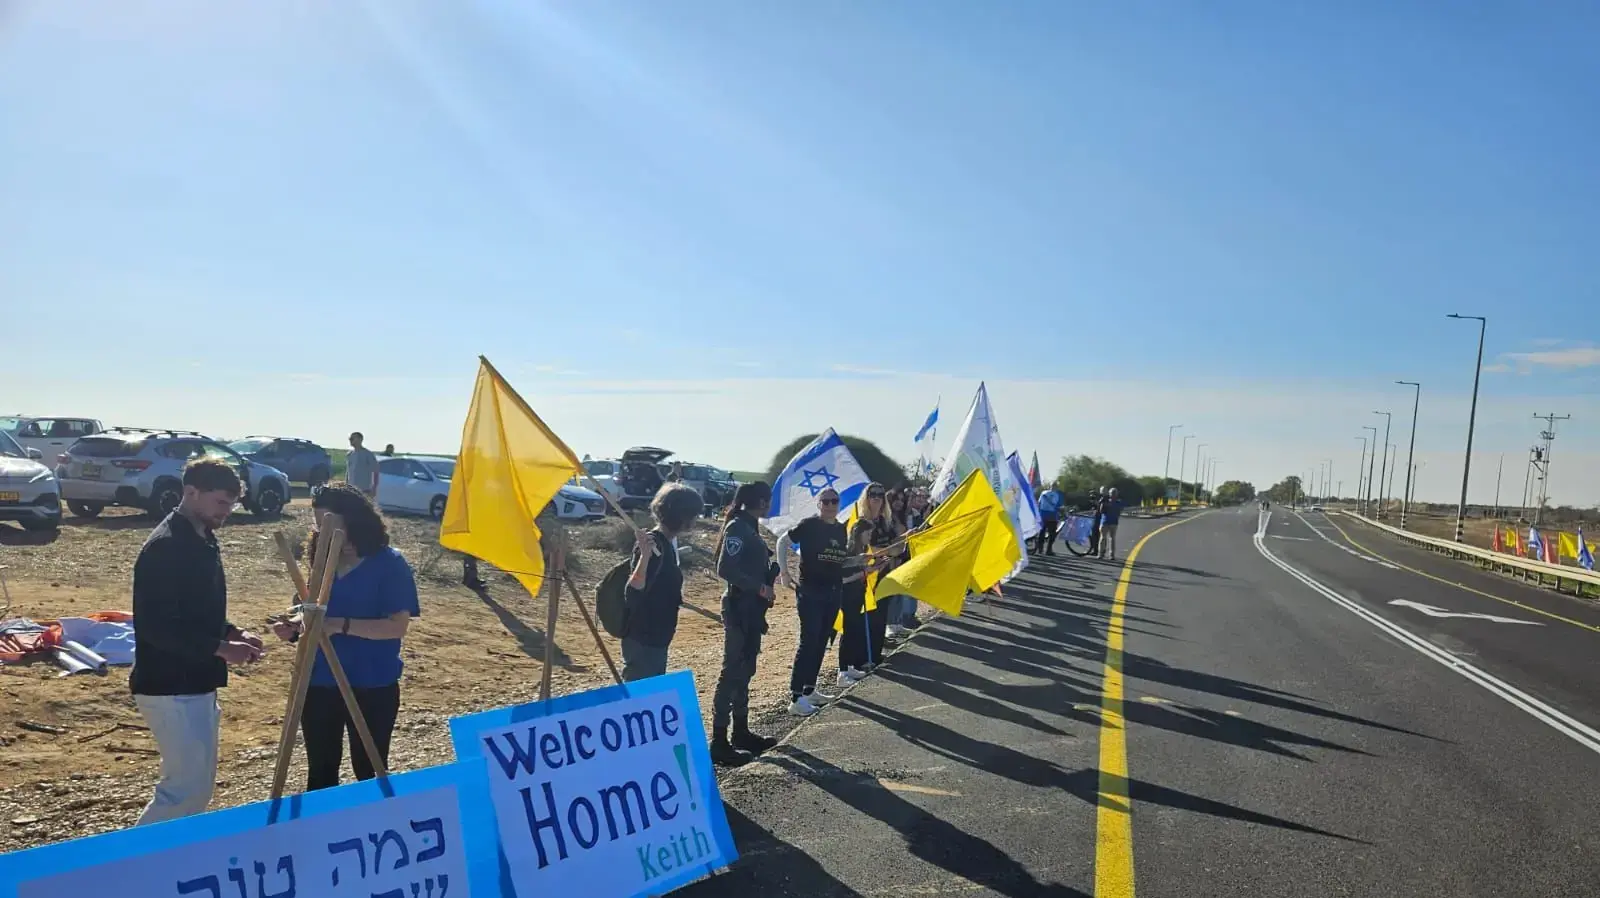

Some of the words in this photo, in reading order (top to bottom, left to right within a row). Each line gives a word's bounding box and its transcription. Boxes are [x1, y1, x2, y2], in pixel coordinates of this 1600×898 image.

[483, 704, 679, 781] Welcome
[519, 743, 697, 870] Home!
[636, 826, 711, 882] Keith
